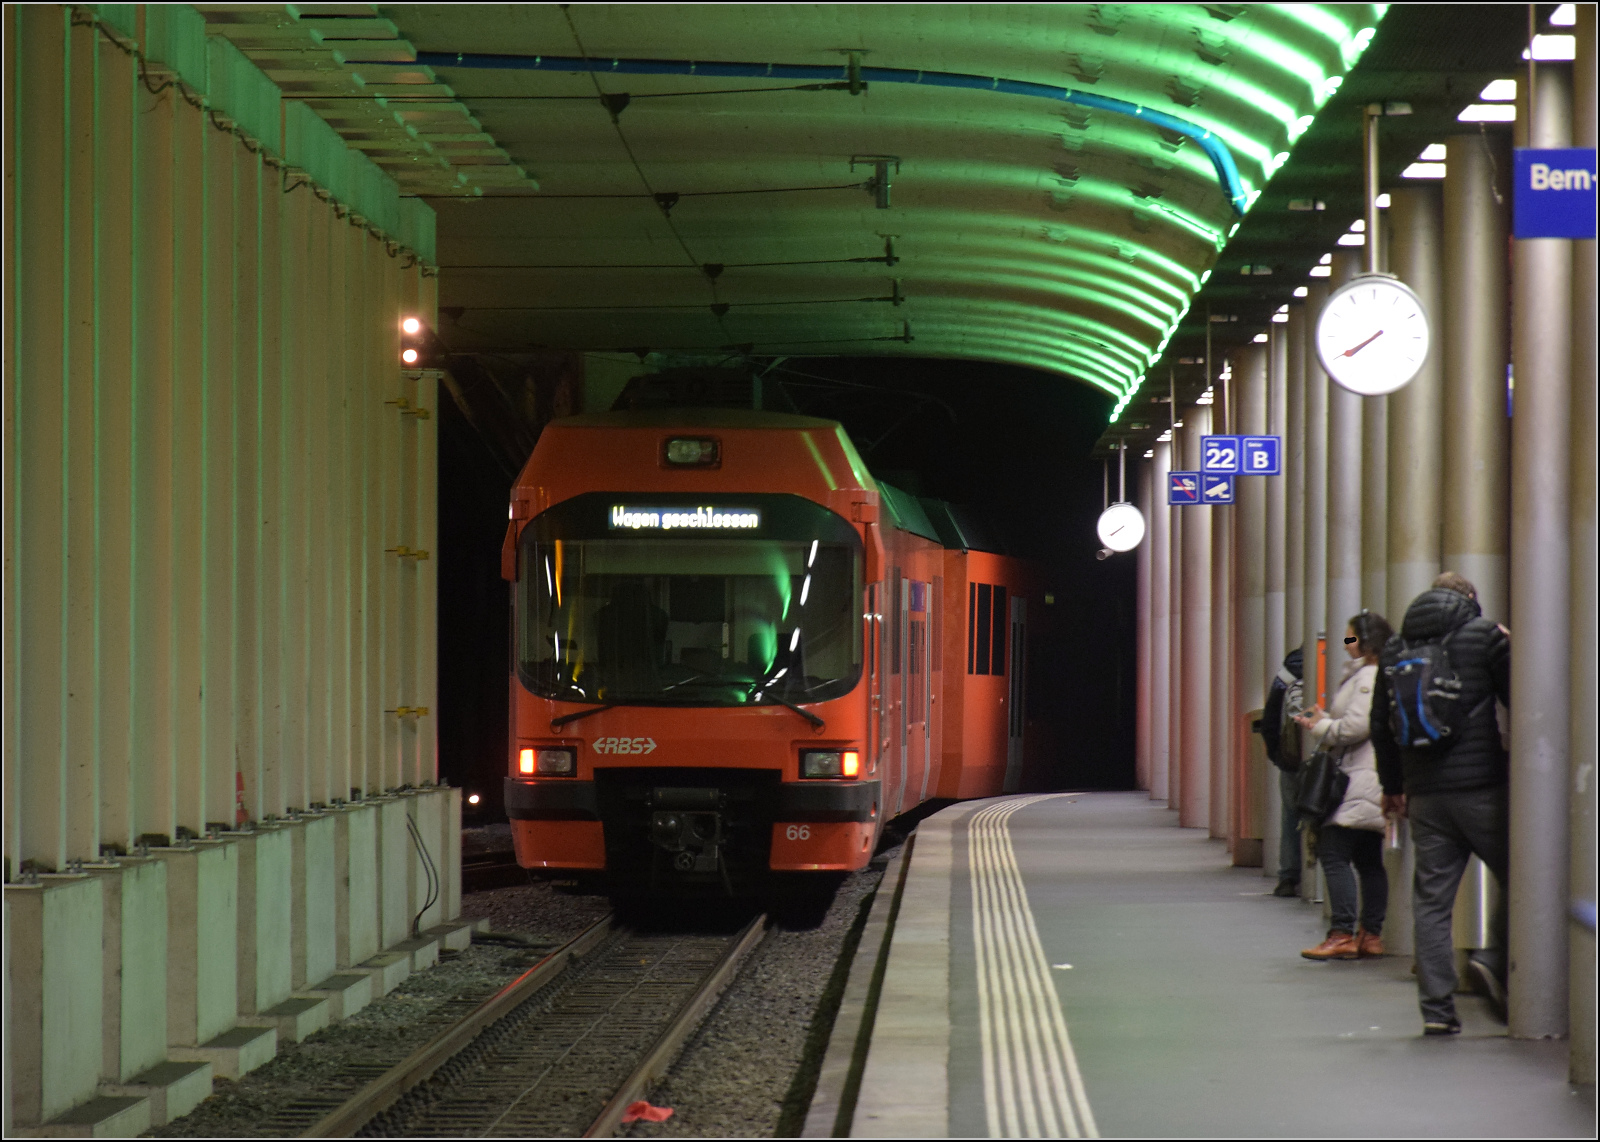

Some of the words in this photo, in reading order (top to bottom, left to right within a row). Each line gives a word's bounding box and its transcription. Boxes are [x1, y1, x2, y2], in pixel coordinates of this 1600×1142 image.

[1206, 448, 1235, 468] 22
[1253, 451, 1269, 469] B
[612, 505, 660, 530] Wagen
[662, 506, 758, 530] geschlossen
[604, 737, 645, 754] RBS
[786, 824, 810, 840] 66
